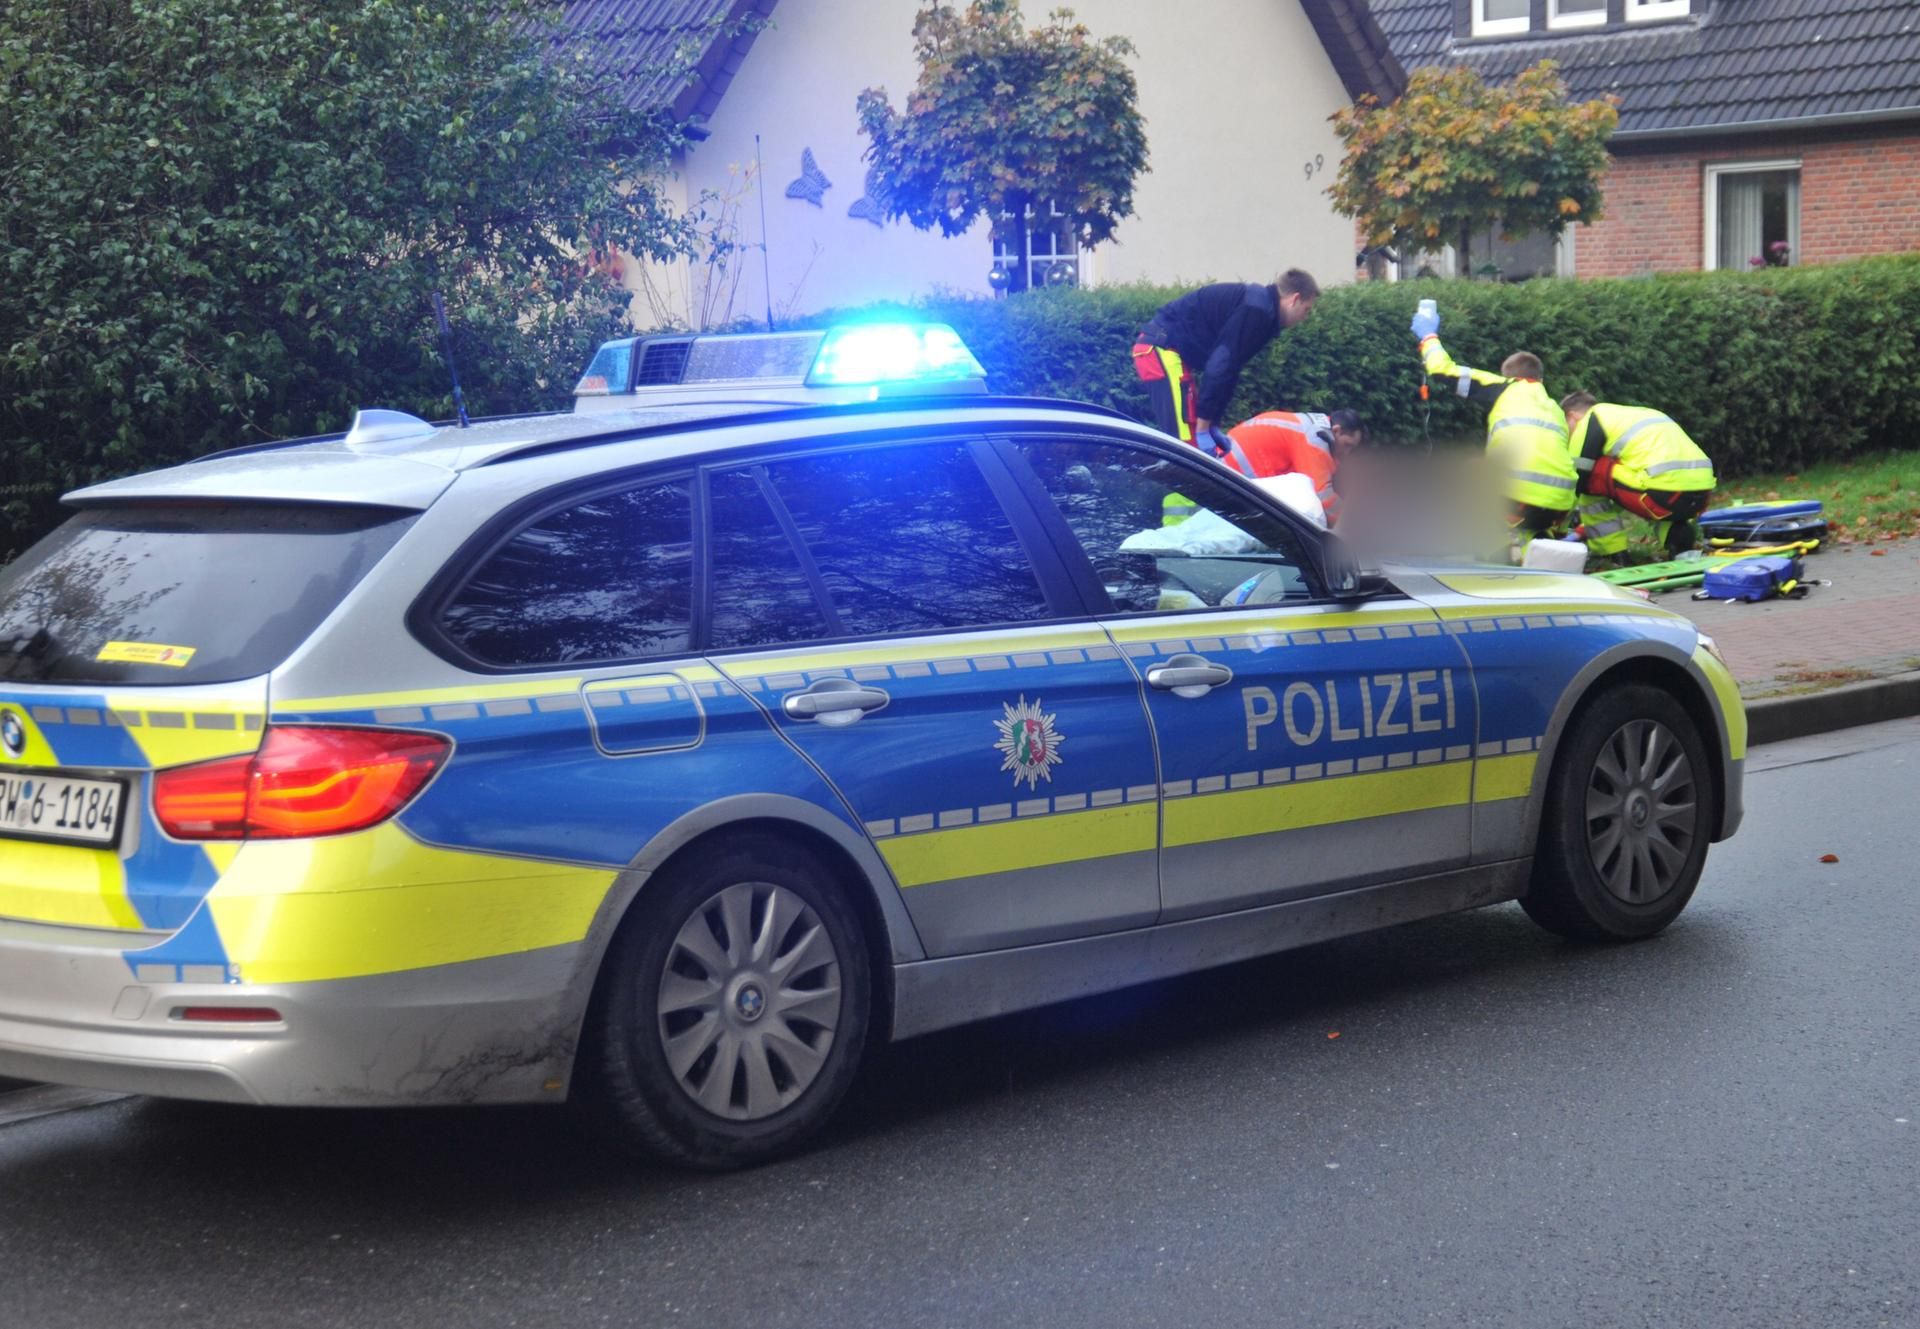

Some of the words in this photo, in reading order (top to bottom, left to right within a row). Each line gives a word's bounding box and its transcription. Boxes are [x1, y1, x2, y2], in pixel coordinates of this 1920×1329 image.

[1304, 153, 1325, 181] 99
[1241, 668, 1456, 751] POLIZEI
[31, 782, 114, 832] 6-1184
